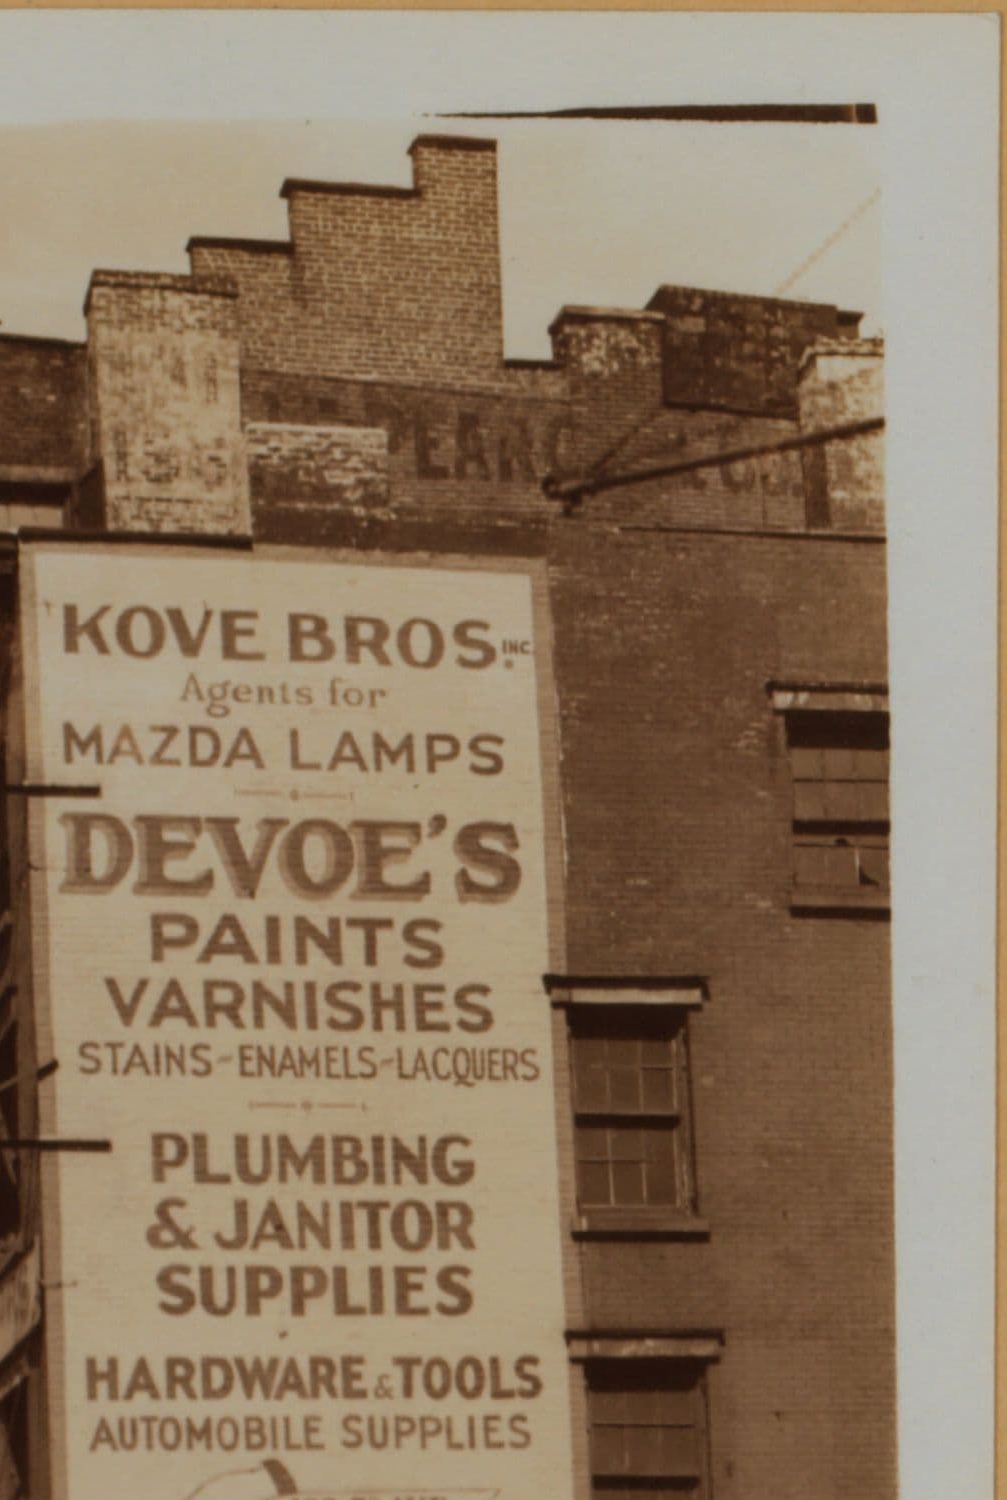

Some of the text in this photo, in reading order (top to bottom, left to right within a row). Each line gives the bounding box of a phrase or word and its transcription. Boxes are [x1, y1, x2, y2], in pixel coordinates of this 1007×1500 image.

[63, 604, 264, 660] KOVE
[181, 674, 387, 718] Agents for
[63, 721, 505, 776] MAZDA LAMPS
[57, 812, 523, 904] DEVOE'S
[149, 912, 445, 968] PAINTS
[104, 977, 494, 1033] VARNISHES
[151, 1131, 476, 1186] PLUMBING
[146, 1197, 476, 1251] & JANITOR
[155, 1264, 474, 1317] SUPPLIES
[85, 1355, 543, 1401] HARDWARE & TOOLS
[89, 1413, 532, 1453] AUTOMOBILE SUPPLIES
